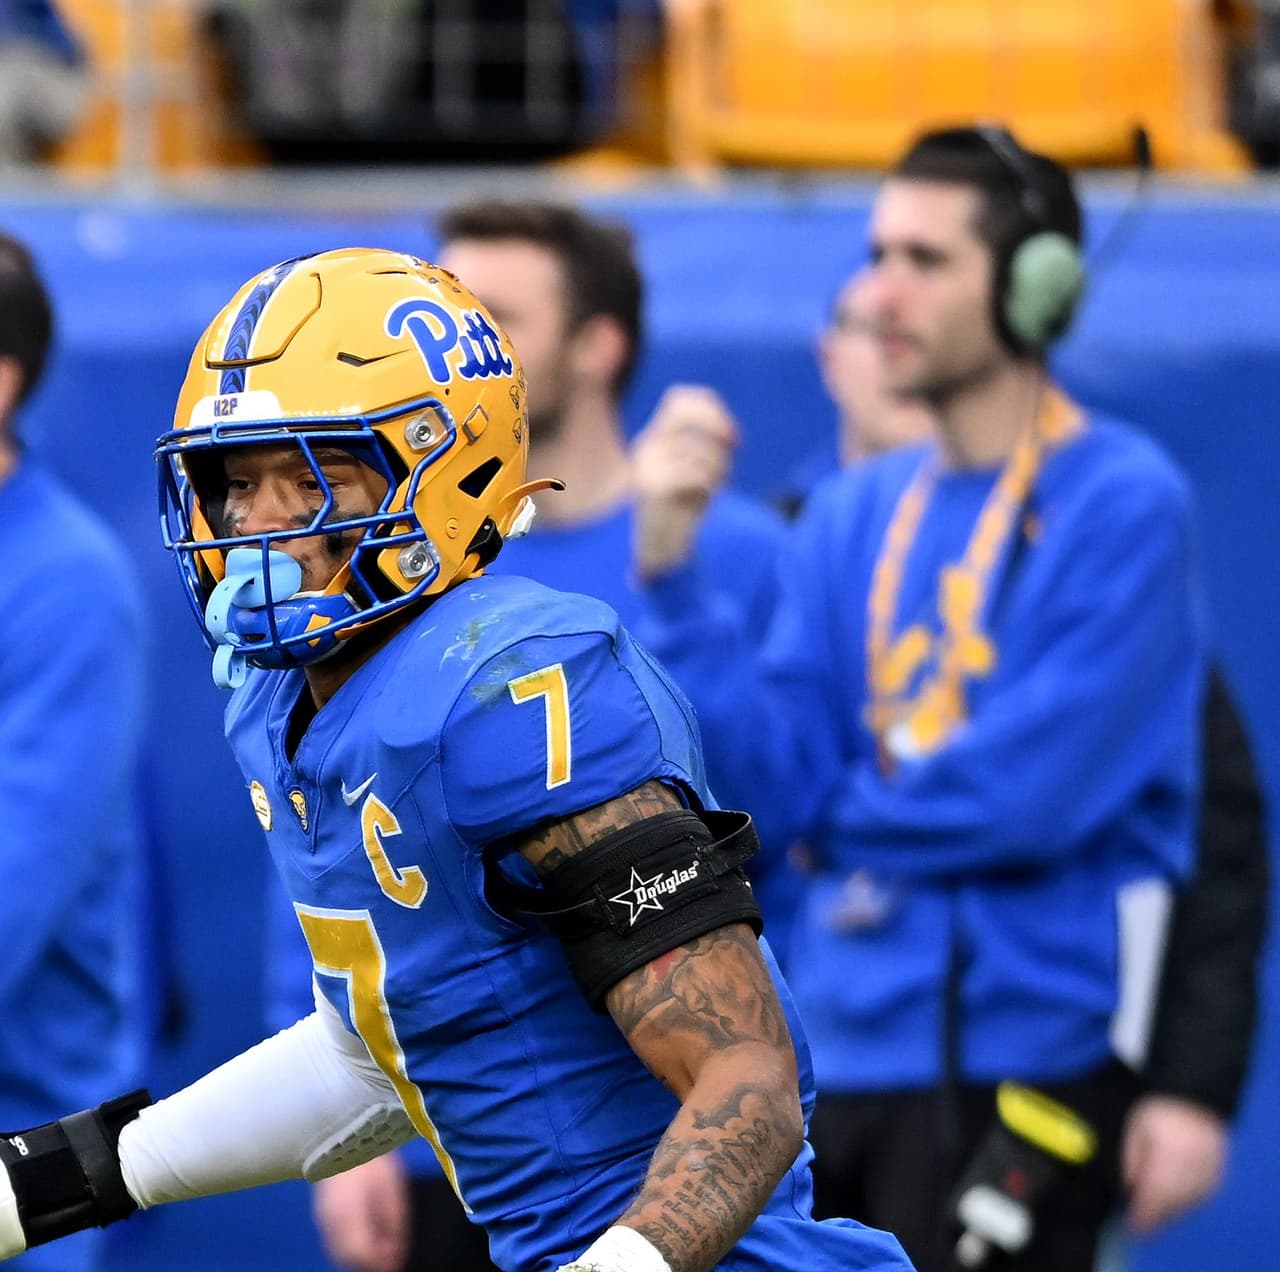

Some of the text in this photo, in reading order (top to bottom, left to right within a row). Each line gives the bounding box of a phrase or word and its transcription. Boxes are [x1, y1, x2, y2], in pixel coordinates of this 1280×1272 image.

[384, 296, 513, 385] Pitt
[213, 397, 238, 417] H2P
[506, 662, 572, 791] 7
[361, 792, 428, 909] C
[633, 866, 699, 906] Douglas
[293, 901, 475, 1214] 7
